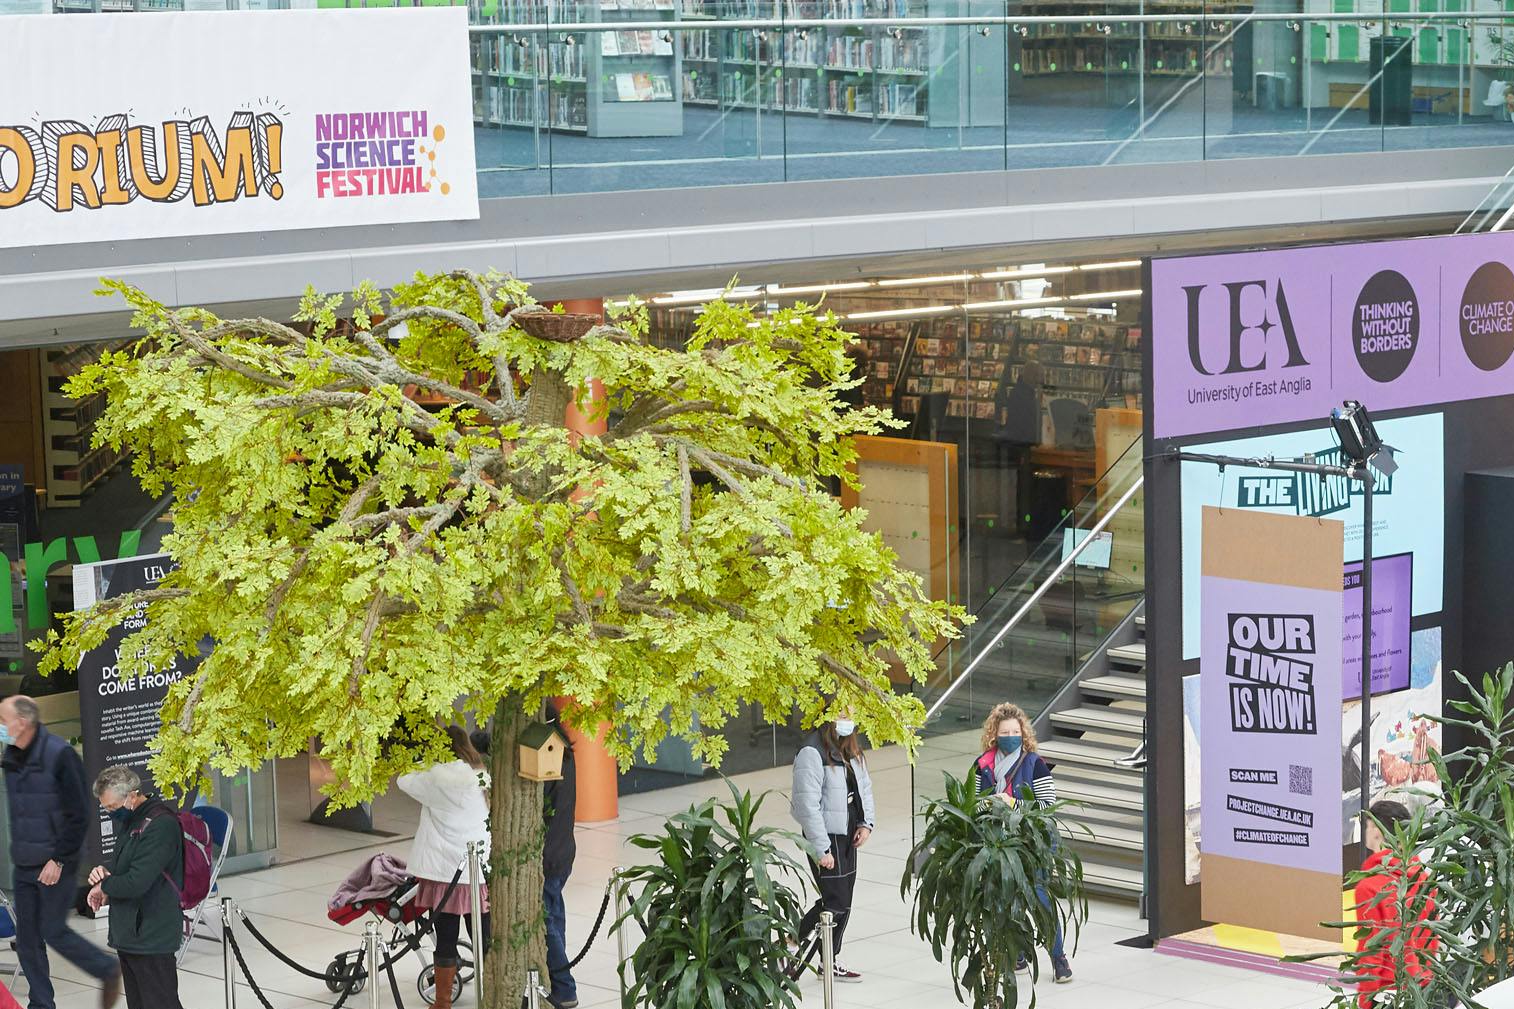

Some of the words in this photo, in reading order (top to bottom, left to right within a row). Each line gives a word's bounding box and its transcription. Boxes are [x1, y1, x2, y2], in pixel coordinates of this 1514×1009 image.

[315, 110, 428, 142] NORWICH
[316, 138, 416, 170] SCIENCE
[316, 166, 430, 198] FESTIVAL
[1182, 277, 1311, 376] UEA
[1359, 300, 1413, 319] THINKING
[1462, 302, 1504, 320] CLIMATE
[1360, 316, 1411, 337] WITHOUT
[1469, 318, 1513, 336] CHANGE
[1360, 334, 1412, 354] BORDERS
[1187, 385, 1242, 406] University
[1241, 380, 1253, 398] of
[1255, 378, 1277, 397] East
[1279, 376, 1312, 400] Anglia
[1243, 478, 1293, 504] THE
[144, 566, 166, 581] UEA
[124, 619, 147, 629] FORM
[1232, 616, 1312, 650] OUR
[98, 678, 136, 696] COME
[138, 671, 182, 690] FROM?
[1230, 648, 1310, 691] TIME
[1233, 687, 1254, 729] IS
[1258, 687, 1312, 731] NOW!
[1231, 770, 1260, 782] SCAN
[1260, 772, 1276, 783] ME
[1228, 798, 1312, 826] PROJECTCHANGE.UEA.AC.UK
[1235, 830, 1309, 845] #CLIMATEOFCHANGE
